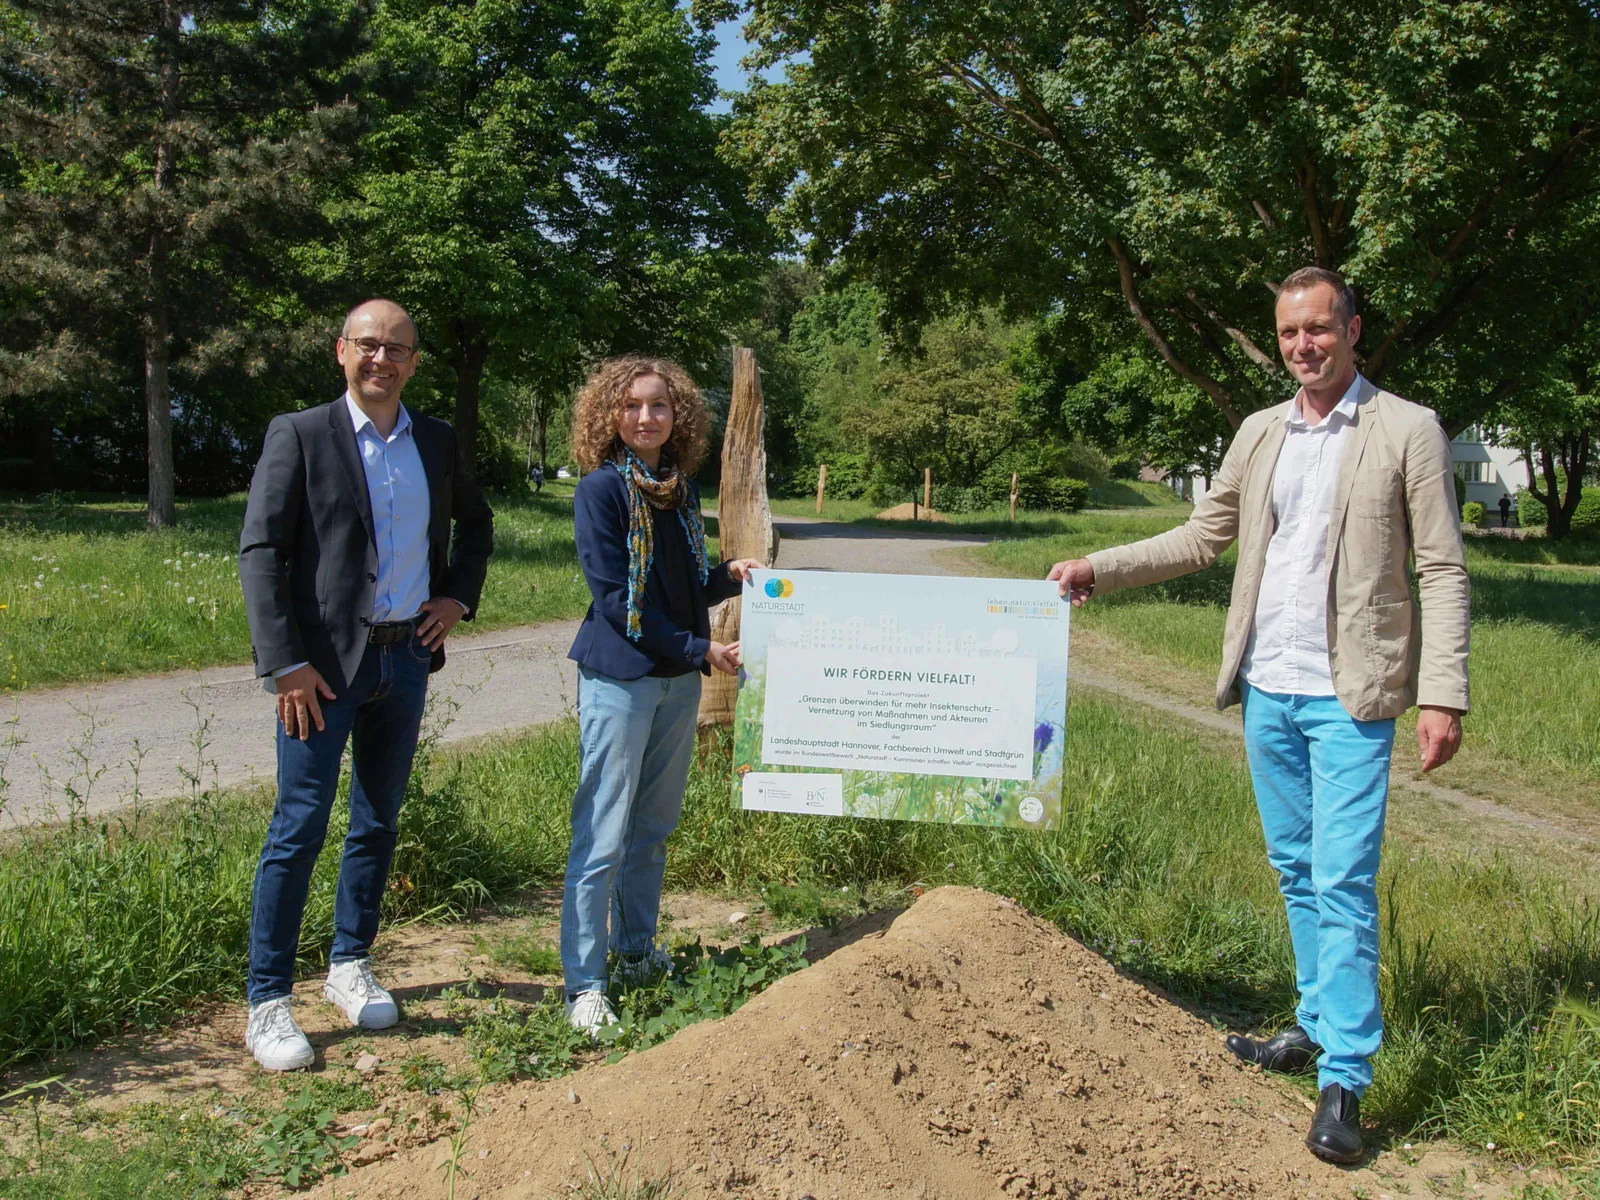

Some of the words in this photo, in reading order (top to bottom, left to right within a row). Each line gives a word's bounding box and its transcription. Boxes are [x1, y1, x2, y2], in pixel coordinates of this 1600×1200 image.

[752, 602, 805, 611] NATURSTADT
[987, 598, 1060, 608] leben.natur.vielfalt
[824, 667, 848, 678] WIR
[852, 666, 912, 682] FÖRDERN
[917, 672, 975, 685] VIELFALT!
[881, 690, 930, 698] Zukunftsprojekt
[798, 695, 836, 704] „Grenzen
[840, 697, 888, 707] überwinden
[930, 702, 991, 712] Insektenschutz
[808, 706, 855, 717] Vernetzung
[875, 710, 928, 720] Maßnahmen
[950, 714, 988, 723] Akteuren
[770, 737, 840, 748] Landeshauptstadt
[842, 741, 881, 751] Hannover,
[884, 744, 931, 753] Fachbereich
[934, 746, 964, 756] Umwelt
[984, 750, 1024, 760] Stadtgrün
[802, 751, 854, 759] Bundeswettbewerb
[976, 762, 1017, 770] ausgezeichnet
